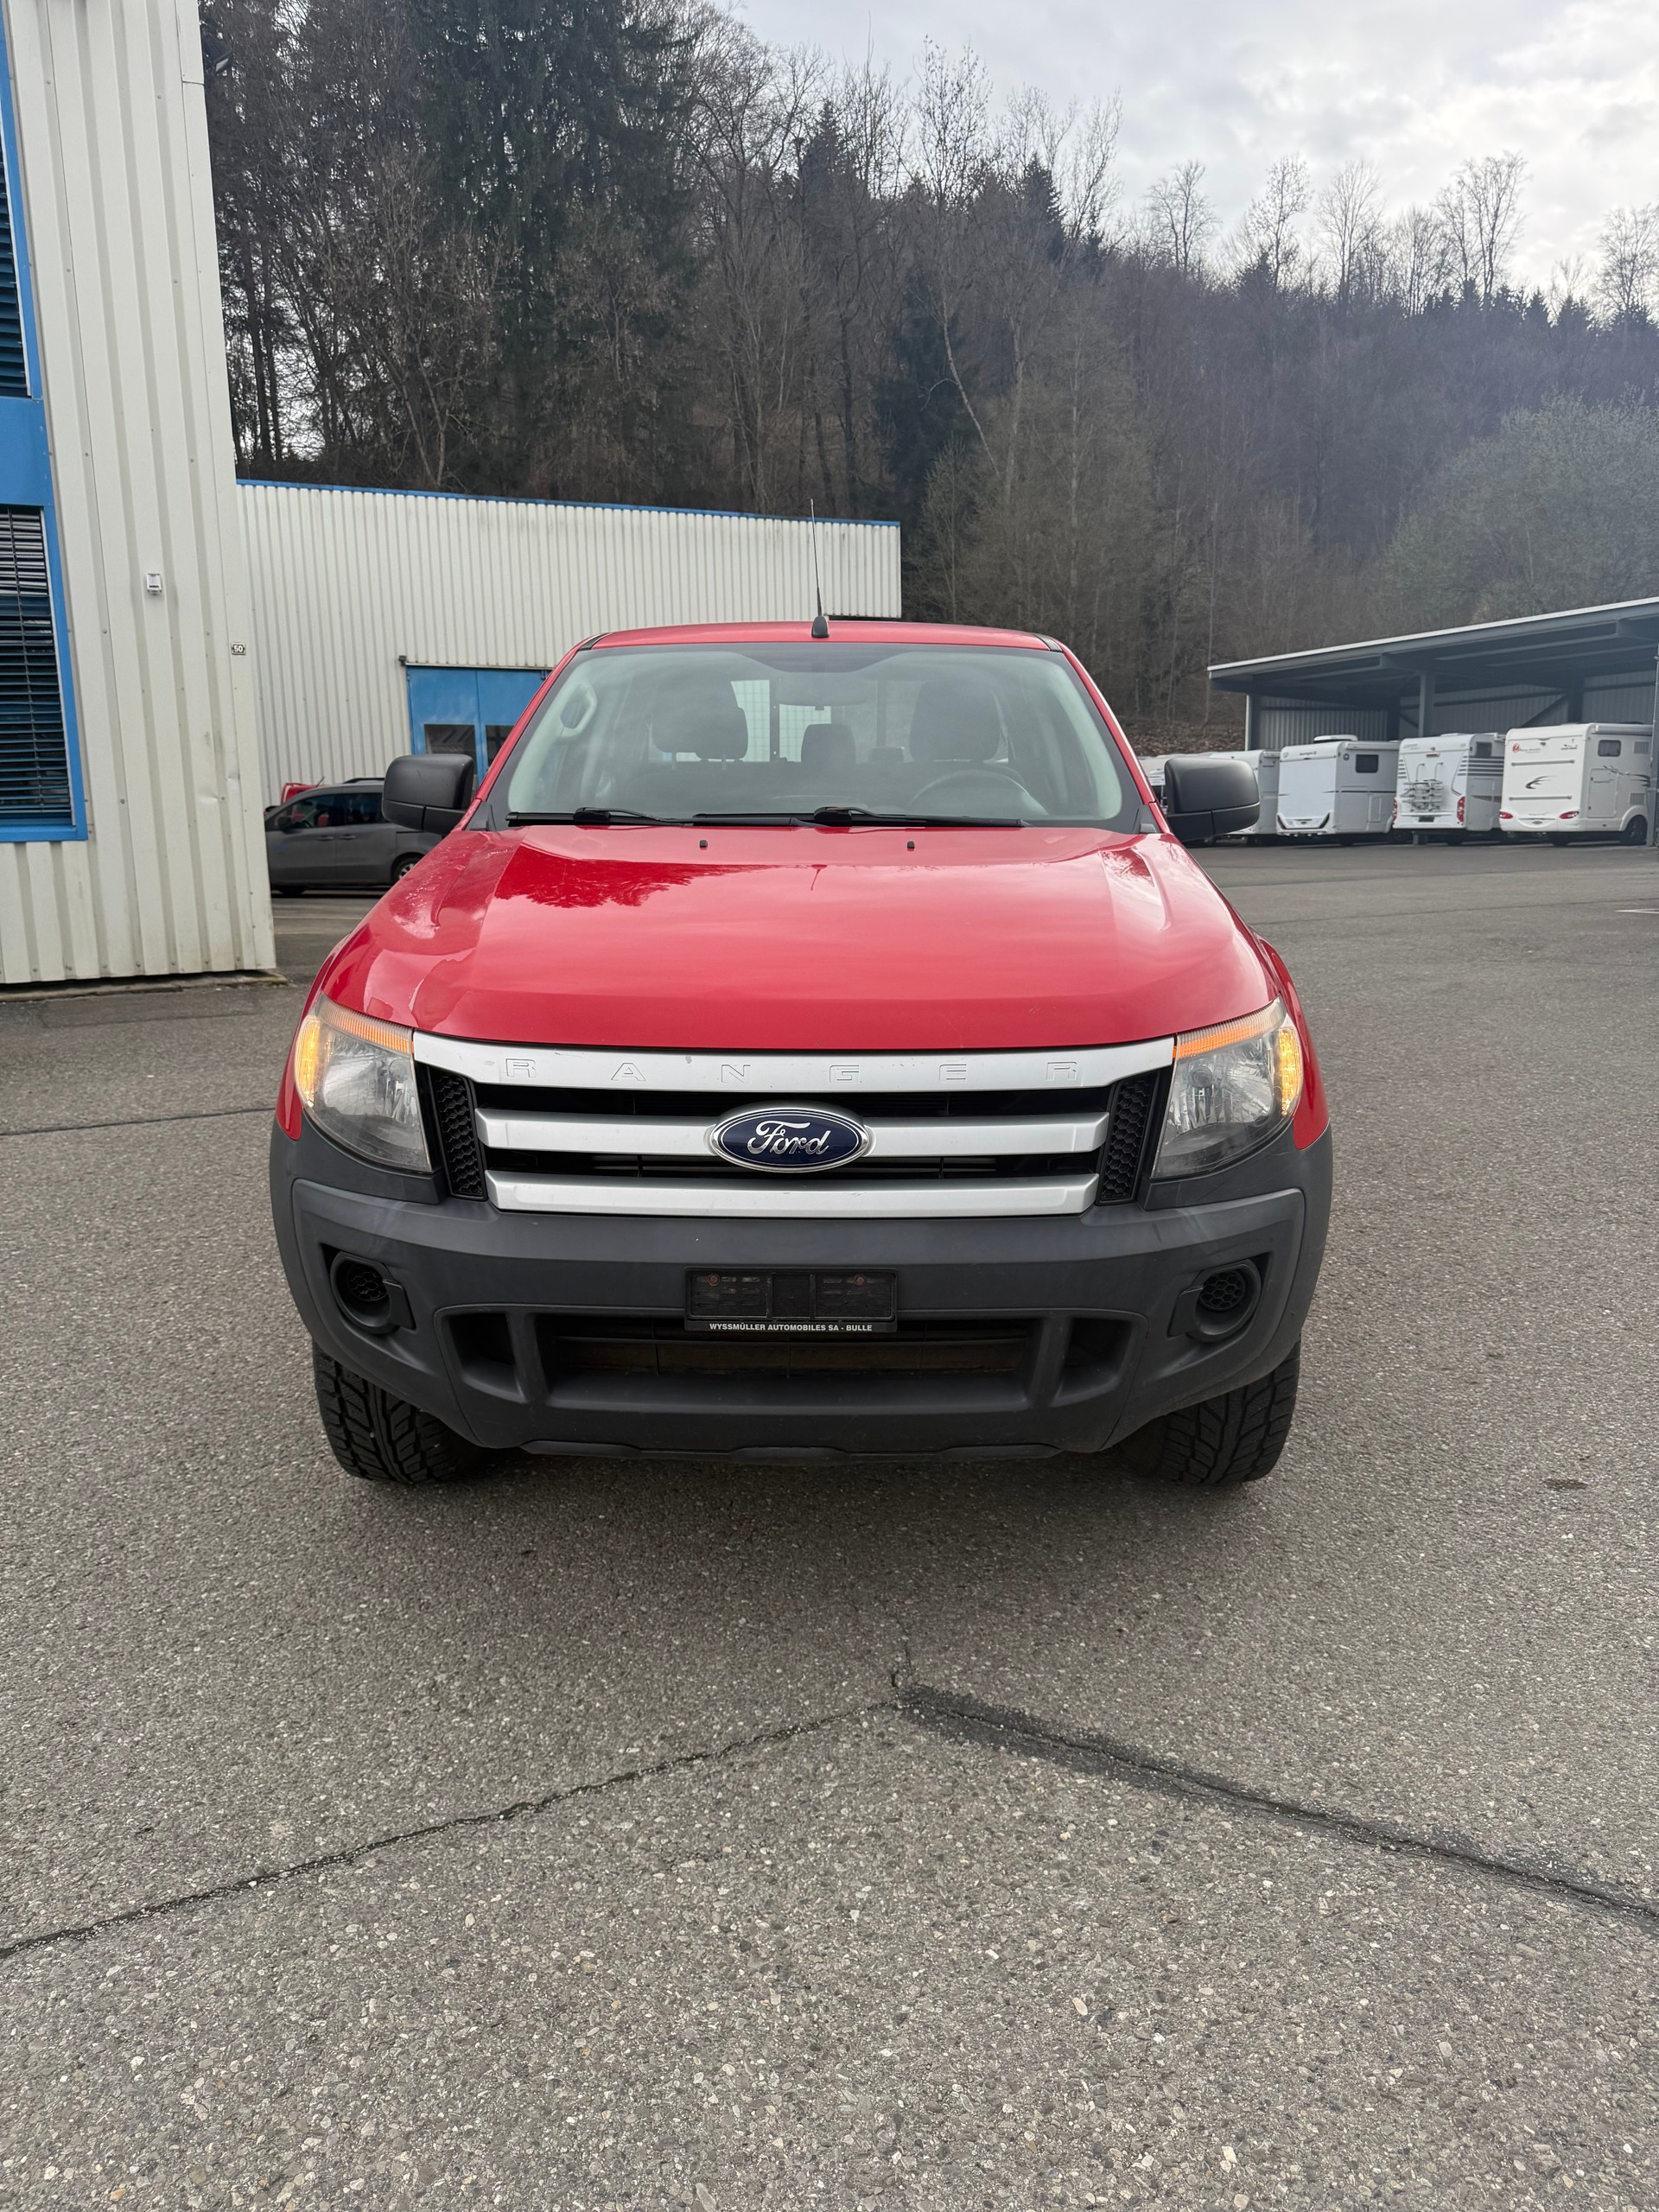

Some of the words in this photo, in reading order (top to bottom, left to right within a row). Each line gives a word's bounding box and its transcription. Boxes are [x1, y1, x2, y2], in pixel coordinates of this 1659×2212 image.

[505, 1058, 1078, 1084] RANGER
[747, 1120, 831, 1155] Ford
[709, 1322, 766, 1331] WYSSMÜLLER
